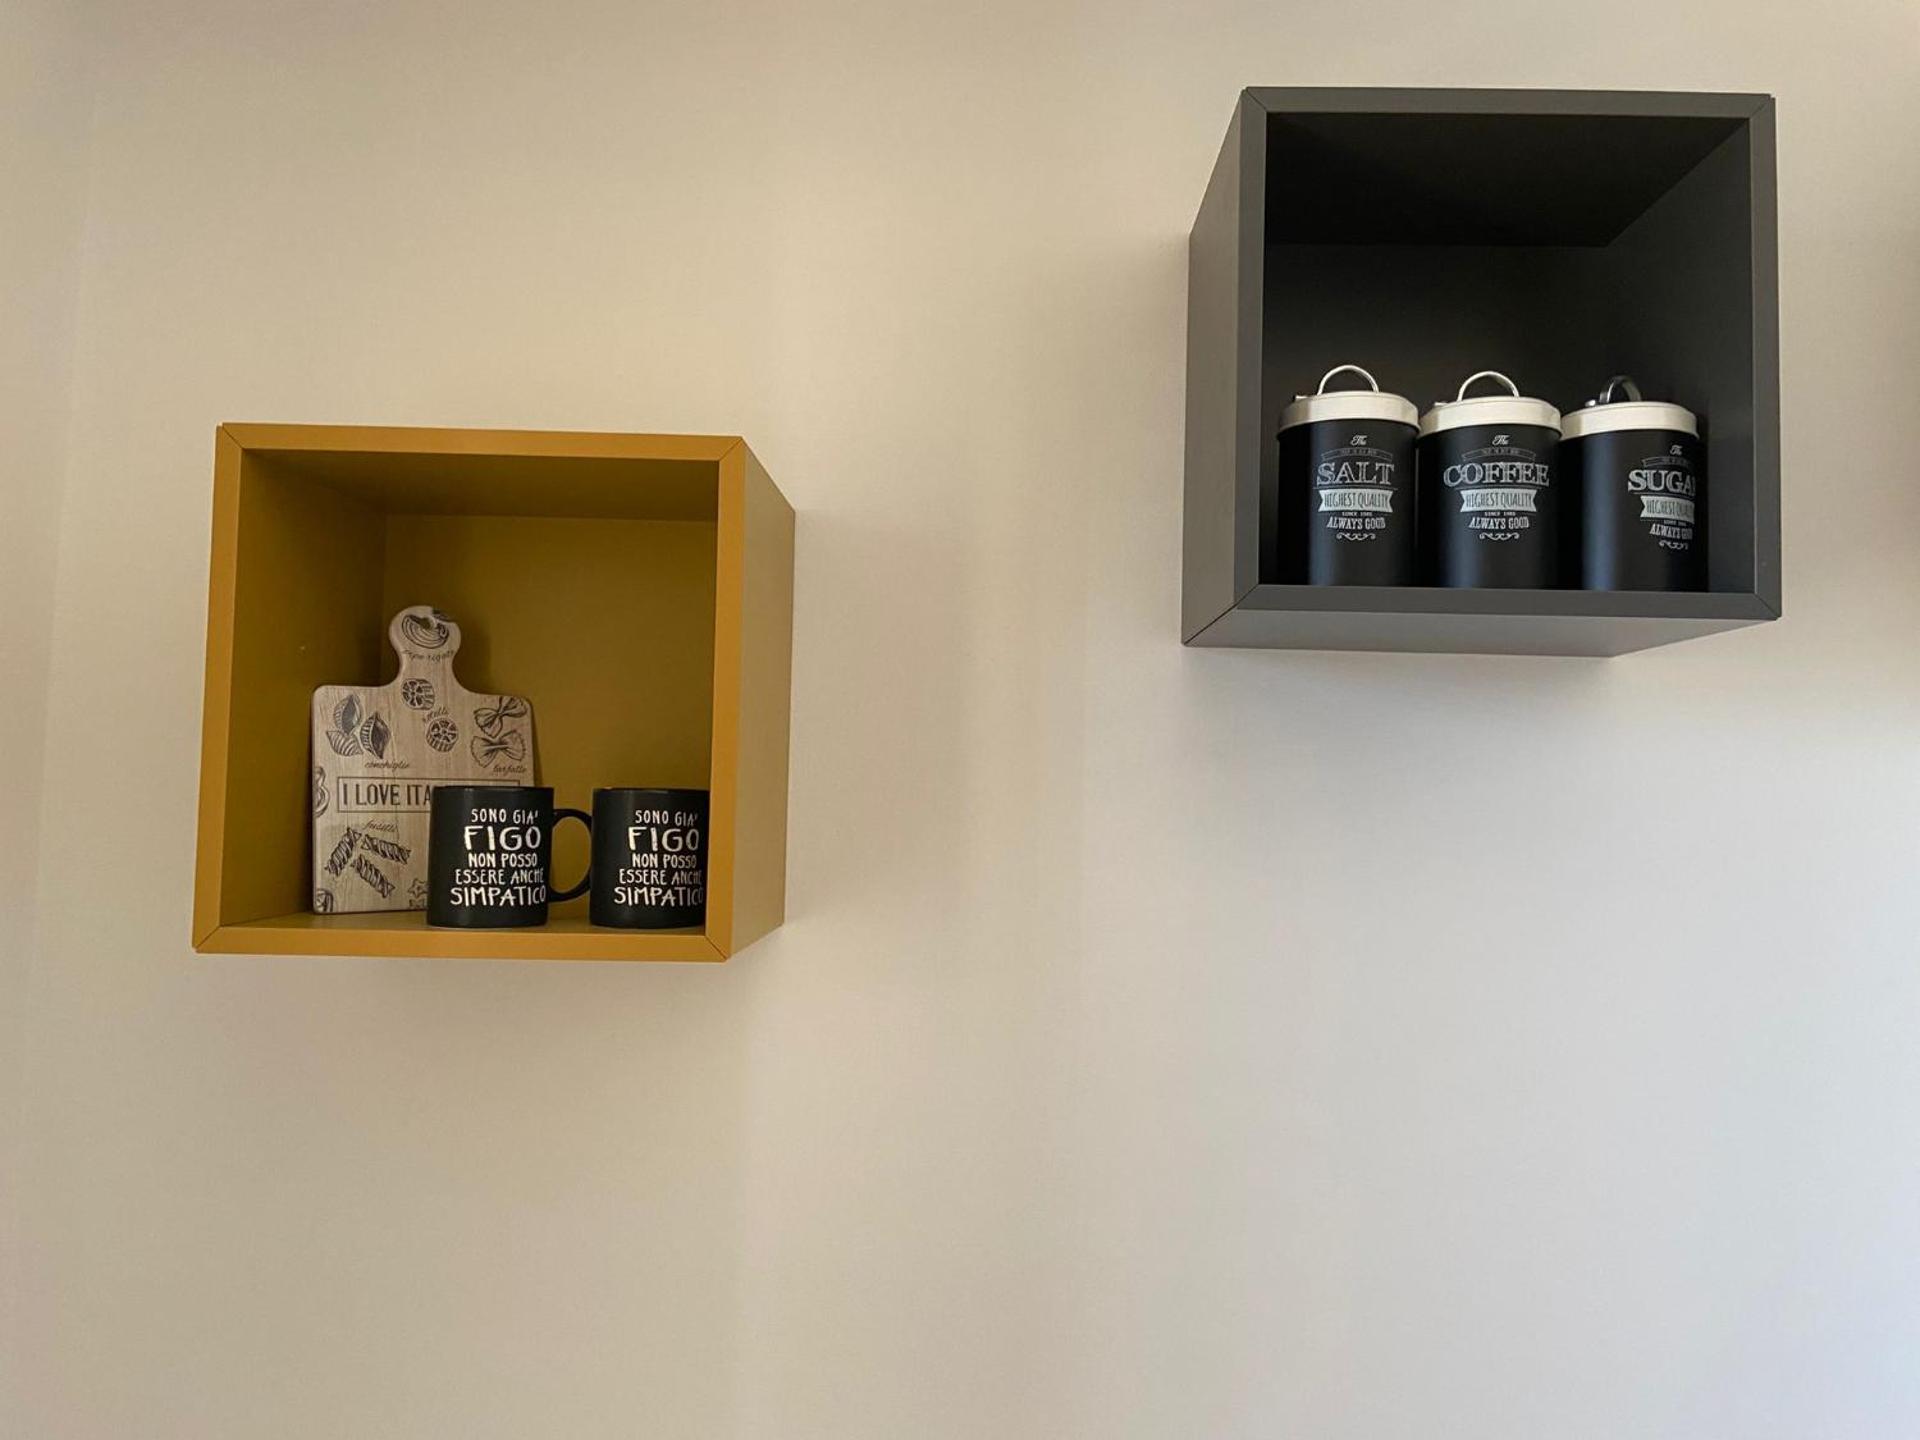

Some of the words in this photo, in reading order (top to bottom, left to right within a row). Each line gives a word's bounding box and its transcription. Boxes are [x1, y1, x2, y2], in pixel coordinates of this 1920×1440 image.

[1350, 434, 1367, 446] The
[1492, 434, 1510, 446] The
[1317, 461, 1395, 486] SALT
[1443, 461, 1549, 487] COFFEE
[1324, 492, 1356, 508] HIGHEST
[1358, 492, 1388, 509] QUALITY
[1466, 492, 1499, 508] HIGHEST
[1500, 492, 1533, 509] QUALITY
[1326, 517, 1363, 530] ALWAYS
[1365, 517, 1386, 530] GOOD
[1468, 517, 1506, 530] ALWAYS
[1508, 516, 1530, 530] GOOD
[1649, 523, 1681, 539] ALWAYS
[342, 783, 348, 806] I
[355, 783, 401, 806] LOVE
[471, 808, 507, 823] SONO
[513, 809, 539, 825] GIA'
[635, 809, 669, 825] SONO
[674, 811, 698, 827] GIA'
[464, 825, 541, 851] FIGO
[628, 826, 699, 852] FIGO
[468, 852, 496, 868] NON
[501, 852, 538, 868] POSSO
[632, 853, 658, 868] NON
[663, 854, 697, 869] POSSO
[455, 868, 505, 885] ESSERE
[510, 867, 544, 885] ANCHE
[619, 868, 667, 885] ESSERE
[671, 869, 702, 886] ANCHE
[450, 885, 547, 907] SIMPATICO
[614, 886, 703, 907] SIMPATICO
